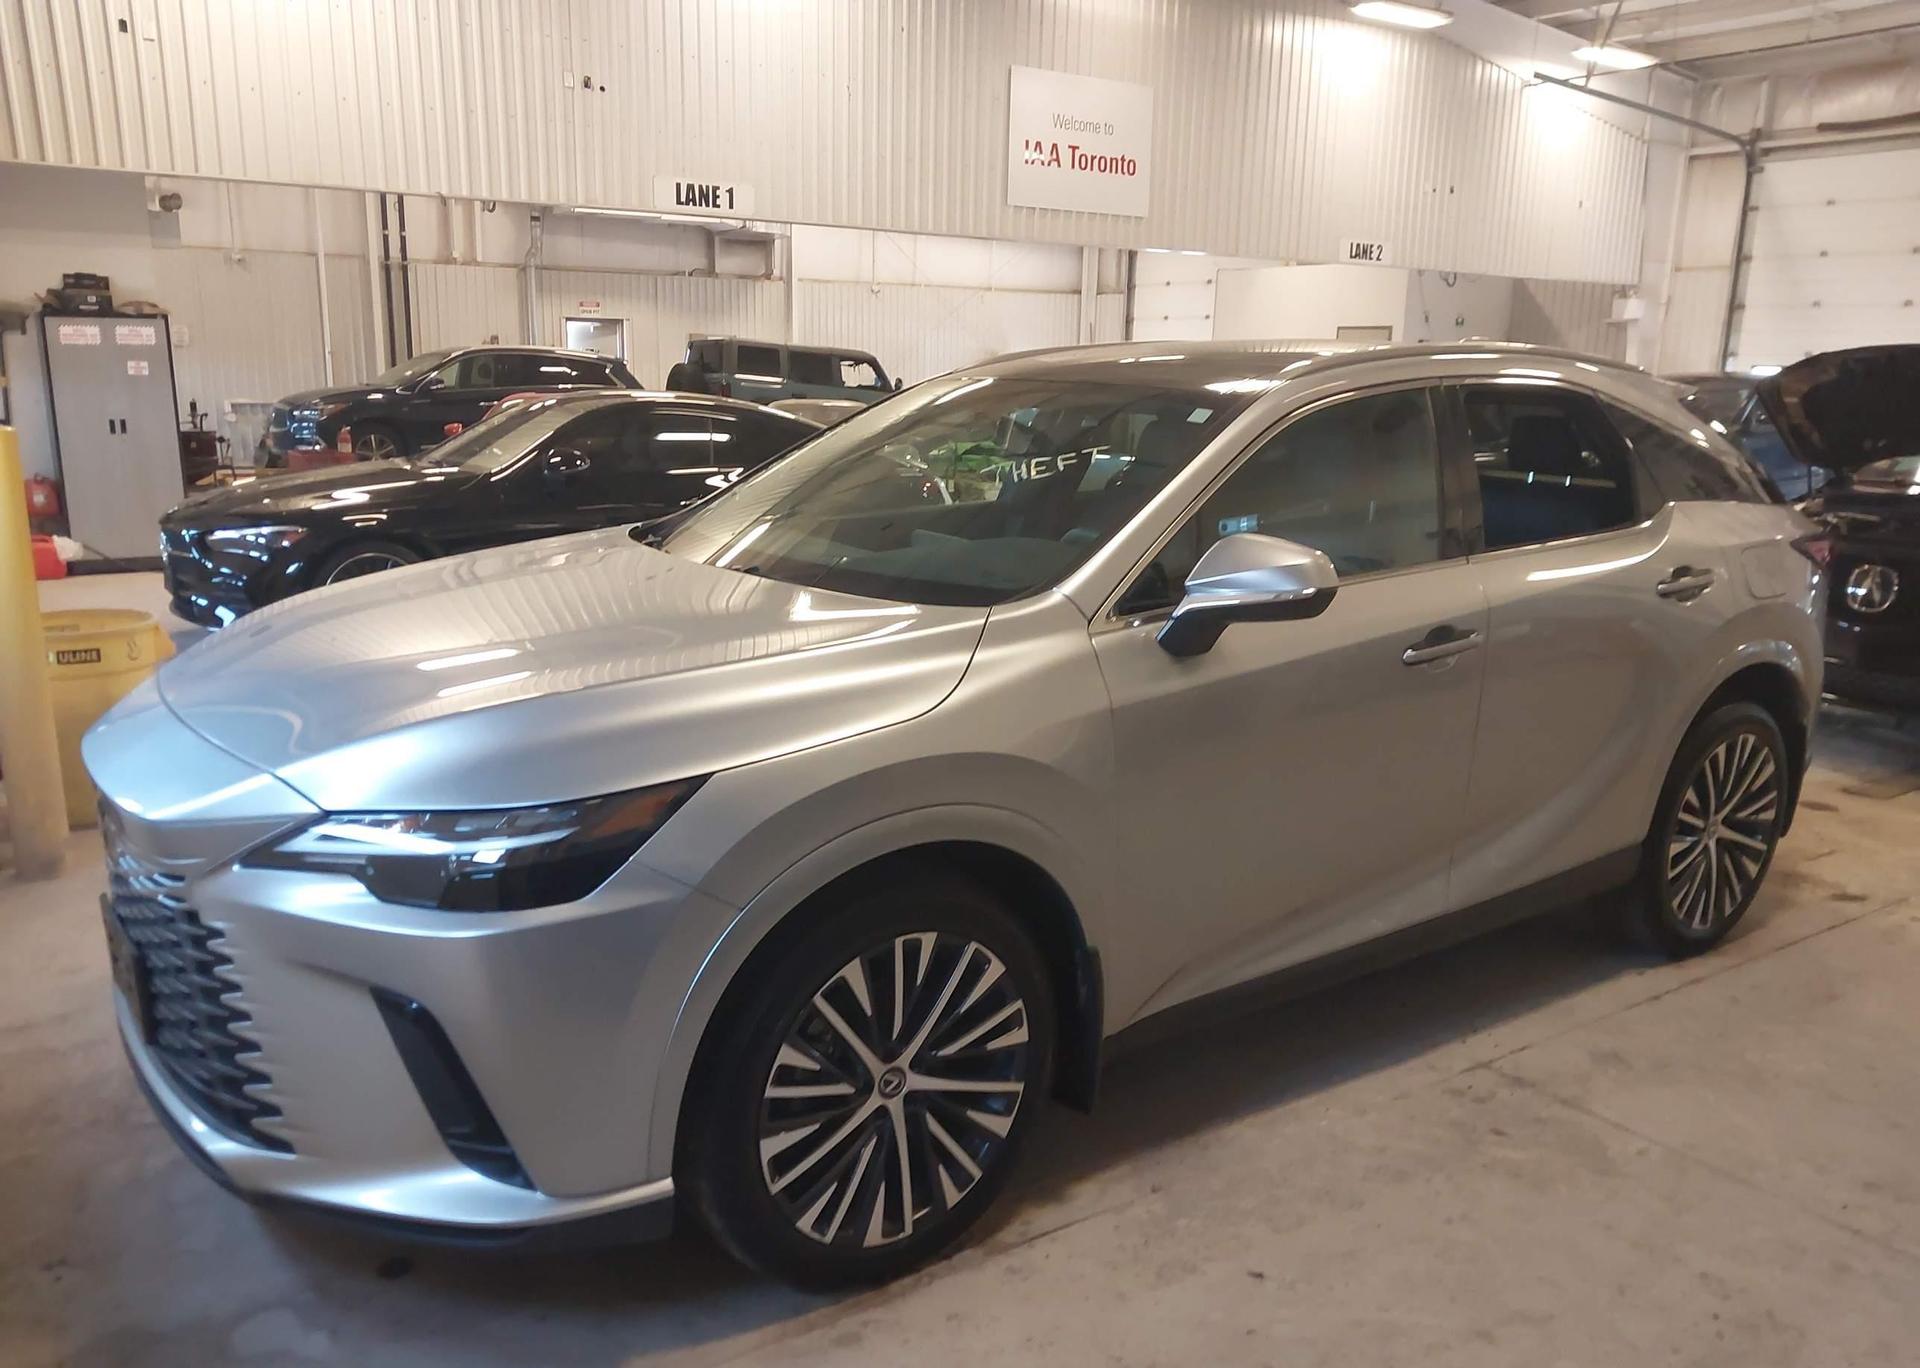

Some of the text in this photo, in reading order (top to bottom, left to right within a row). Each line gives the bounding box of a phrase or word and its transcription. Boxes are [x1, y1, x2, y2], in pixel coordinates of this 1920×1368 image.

[1052, 112, 1114, 136] Welcome to
[1024, 139, 1137, 177] IAA Toronto
[675, 182, 734, 210] LANE 1
[1349, 241, 1383, 261] LANE 2
[980, 445, 1111, 486] THEFT
[58, 650, 99, 663] ULINE
